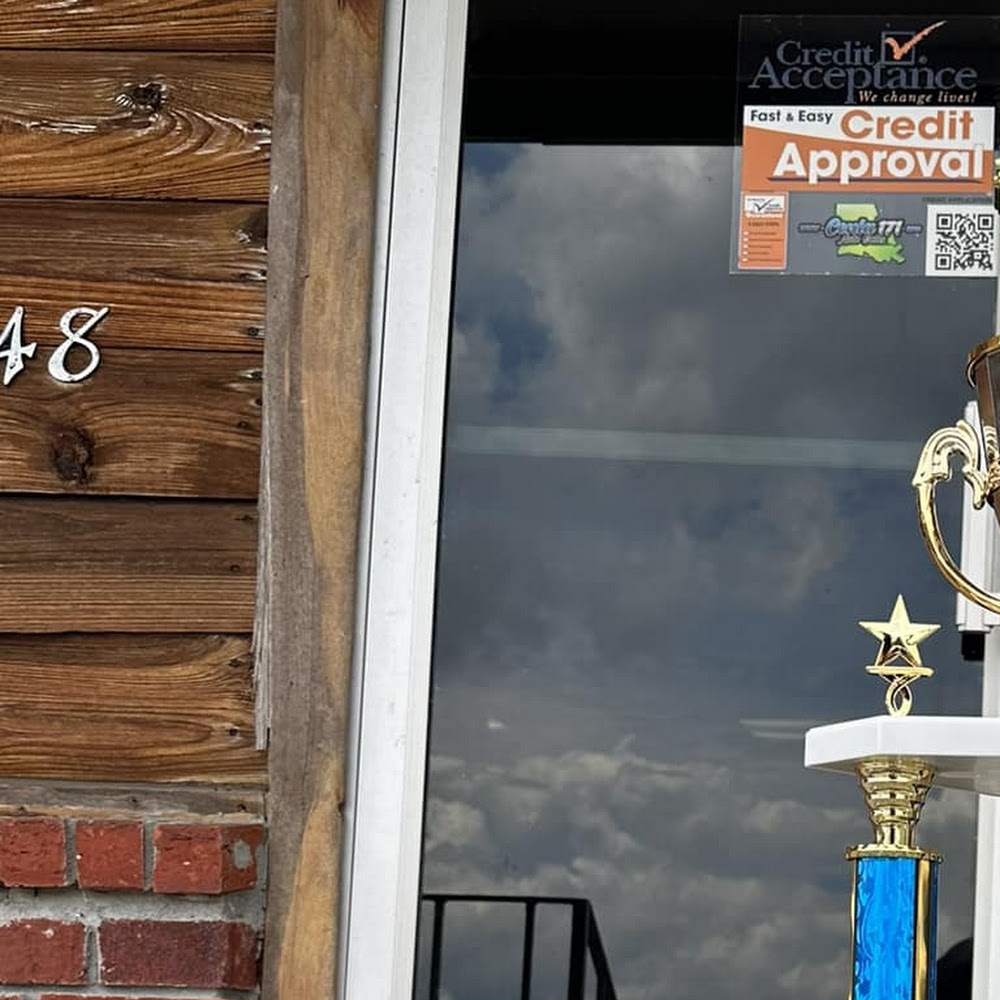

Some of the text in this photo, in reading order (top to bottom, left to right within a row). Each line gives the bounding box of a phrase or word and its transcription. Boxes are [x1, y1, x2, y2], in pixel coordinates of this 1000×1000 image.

[776, 41, 874, 66] Credit
[748, 57, 978, 105] Acceptance
[858, 90, 977, 105] We change lives!
[750, 110, 833, 124] Fast & Easy
[840, 109, 974, 140] Credit
[773, 142, 983, 184] Approval
[0, 305, 109, 386] 48
